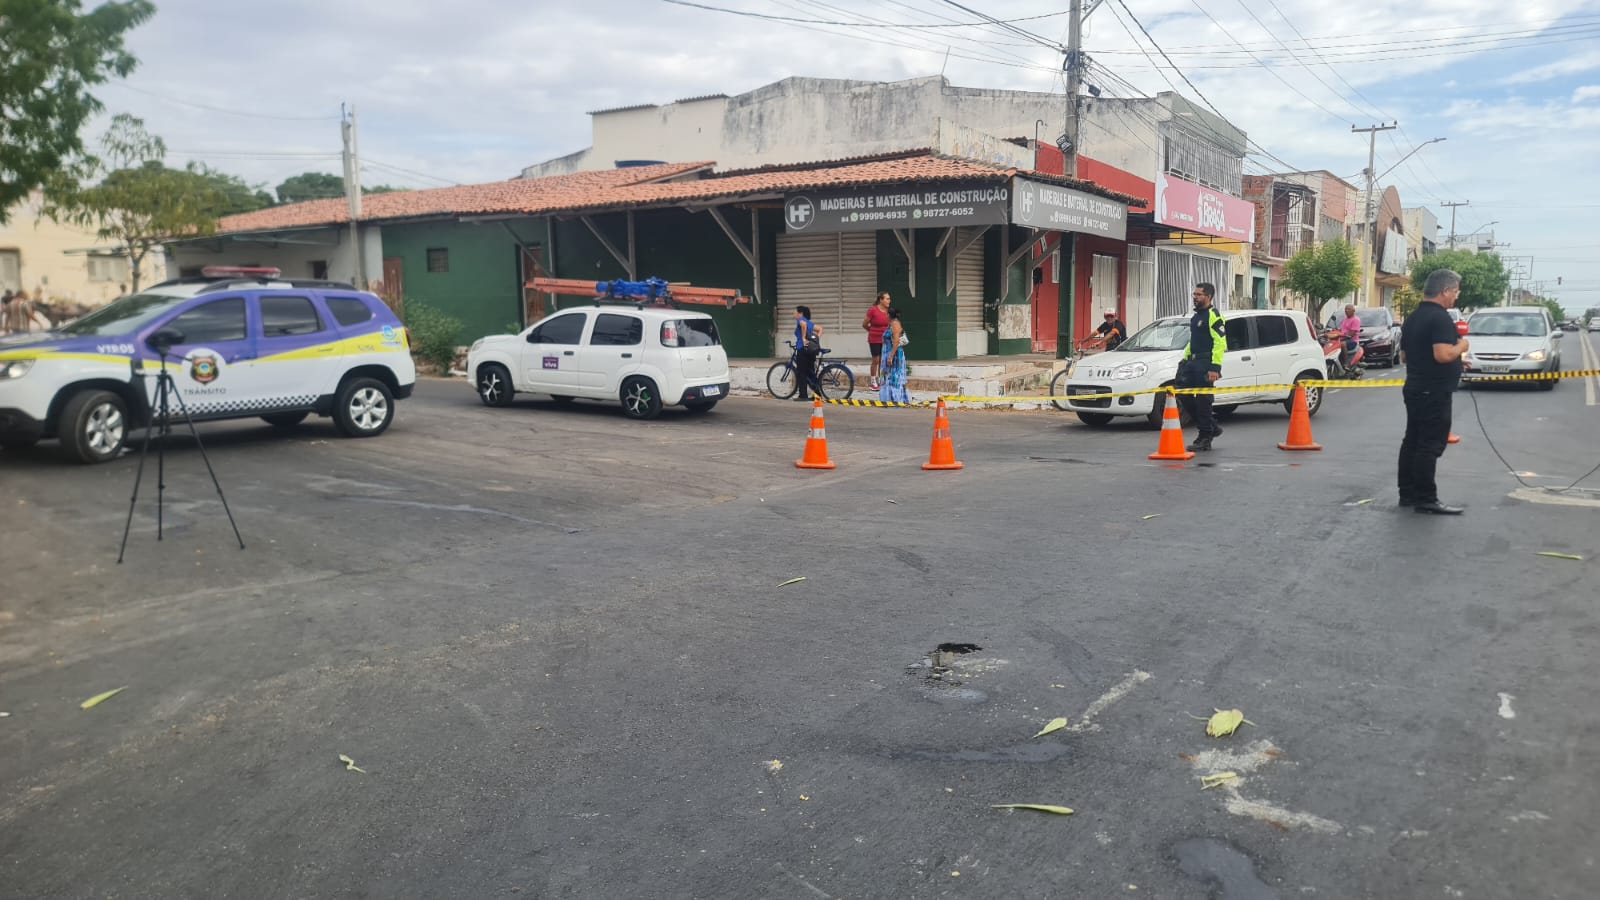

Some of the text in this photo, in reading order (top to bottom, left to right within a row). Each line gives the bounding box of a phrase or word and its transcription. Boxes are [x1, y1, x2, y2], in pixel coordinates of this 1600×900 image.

[820, 186, 1008, 210] MADEIRAS E MATERIAL DE CONSTRUÇÃO
[1022, 190, 1033, 213] HF
[1040, 188, 1063, 206] MADEIRAS
[1063, 194, 1067, 208] E
[1067, 194, 1089, 212] MATERIAL
[1089, 200, 1095, 213] DE
[790, 204, 811, 222] HF
[859, 211, 907, 221] 99999-6935
[923, 208, 974, 217] 98727-6052
[1203, 202, 1225, 232] BRASA
[184, 387, 226, 395] TRÂNSITO
